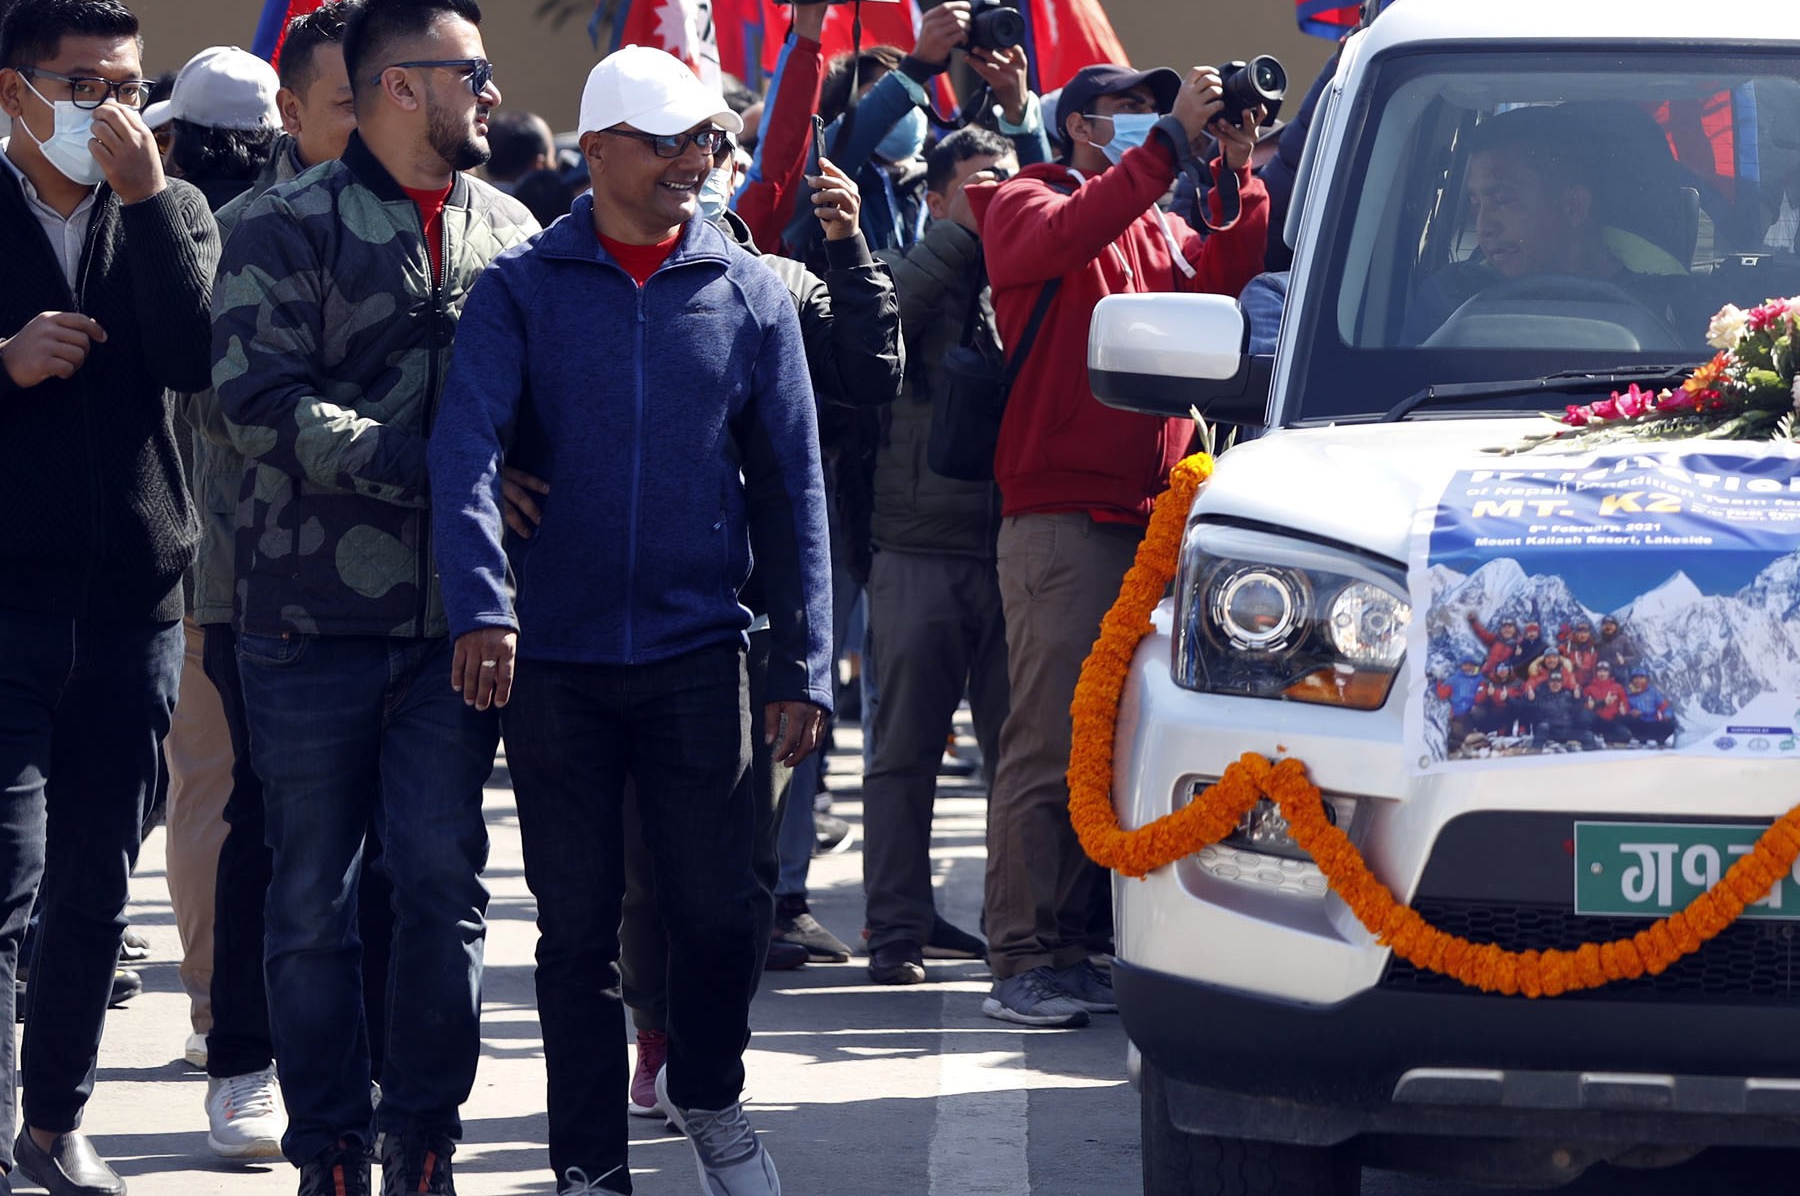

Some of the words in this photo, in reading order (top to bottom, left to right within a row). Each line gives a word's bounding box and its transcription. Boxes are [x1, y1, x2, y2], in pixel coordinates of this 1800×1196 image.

[1471, 499, 1576, 518] MT.
[1598, 491, 1683, 517] K2
[1625, 522, 1662, 533] 2021
[1474, 537, 1522, 547] Mount
[1525, 535, 1583, 546] Kailash
[1585, 535, 1641, 547] Resort,
[1645, 535, 1713, 547] Lakeside
